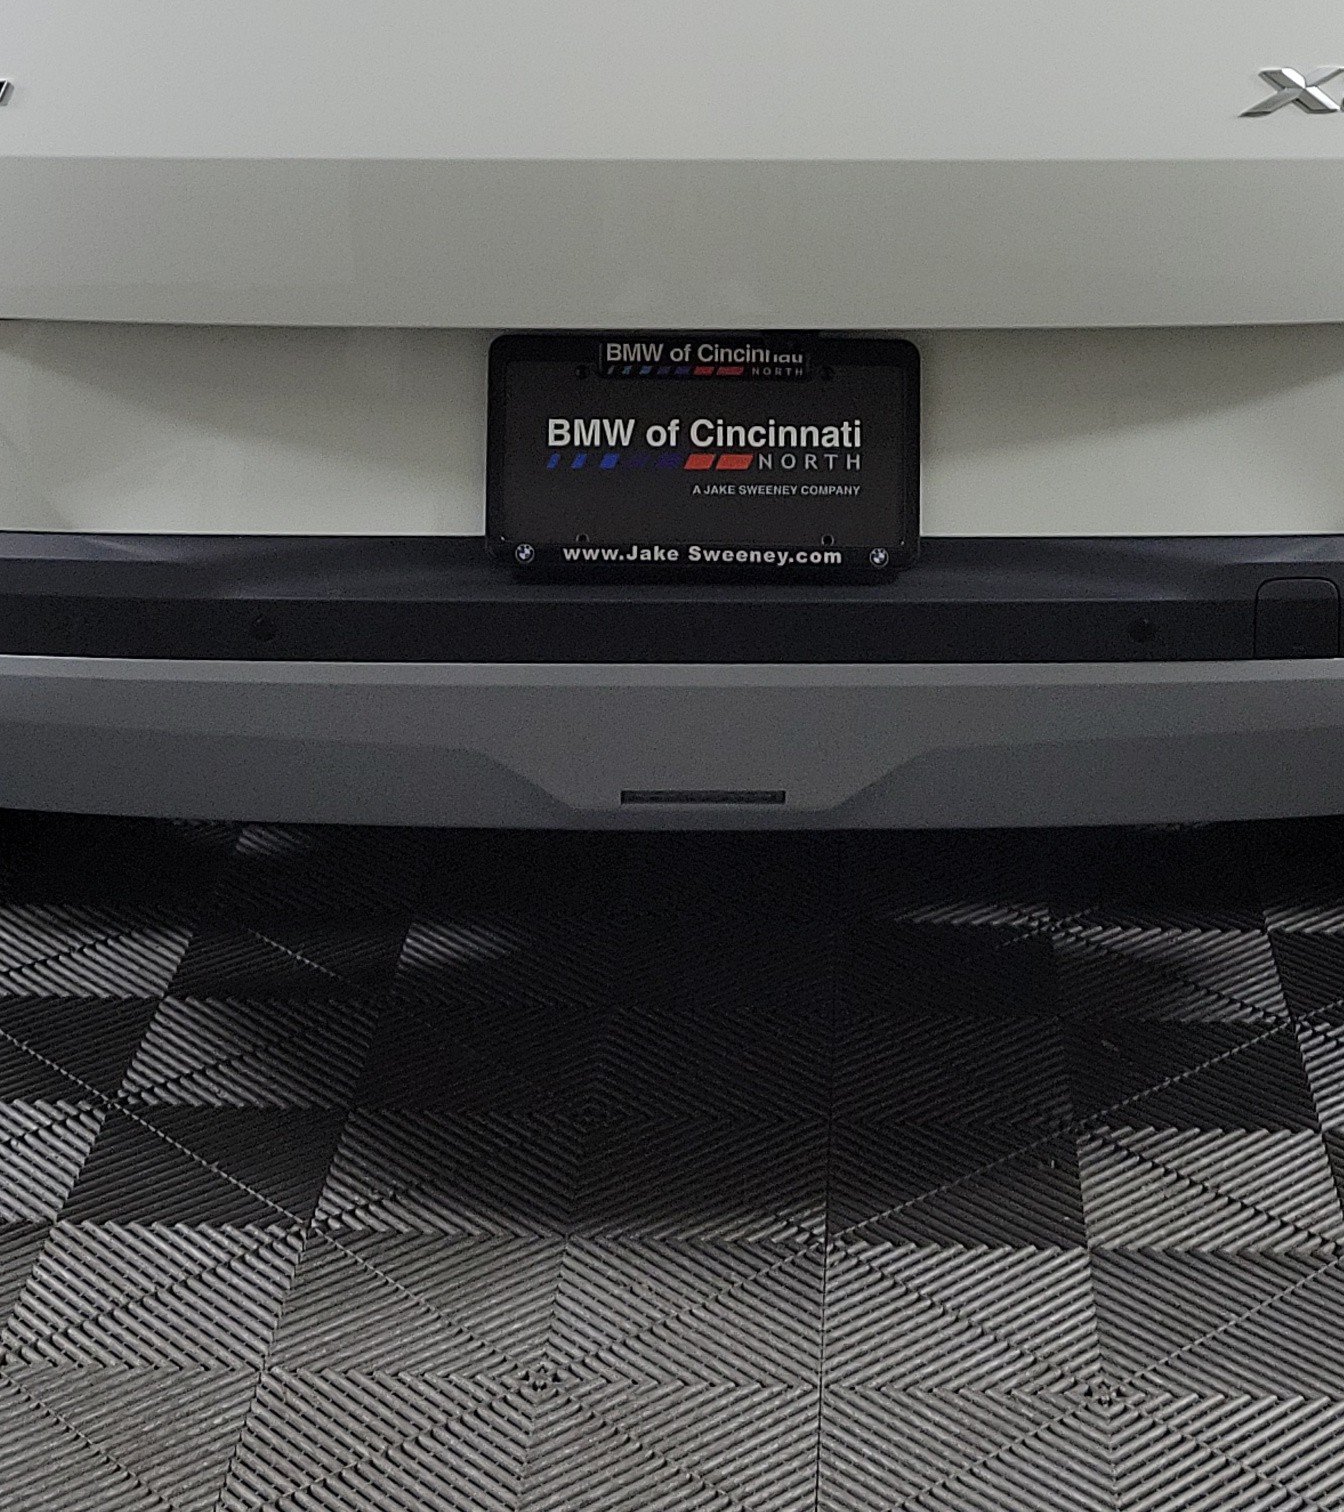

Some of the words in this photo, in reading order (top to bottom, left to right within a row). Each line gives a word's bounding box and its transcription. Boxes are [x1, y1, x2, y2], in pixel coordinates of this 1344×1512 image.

[606, 343, 664, 362] BMW
[669, 343, 692, 363] of
[752, 366, 803, 376] NORTH
[547, 419, 635, 447] BMW
[646, 419, 680, 448] of
[690, 419, 862, 448] Cincinnati
[758, 454, 861, 471] NORTH
[692, 486, 702, 496] A
[703, 486, 736, 496] JAKE
[738, 486, 798, 496] SWEENEY
[800, 486, 861, 496] COMPANY
[563, 546, 679, 562] www.Jake
[688, 546, 842, 566] Sweeney.com
